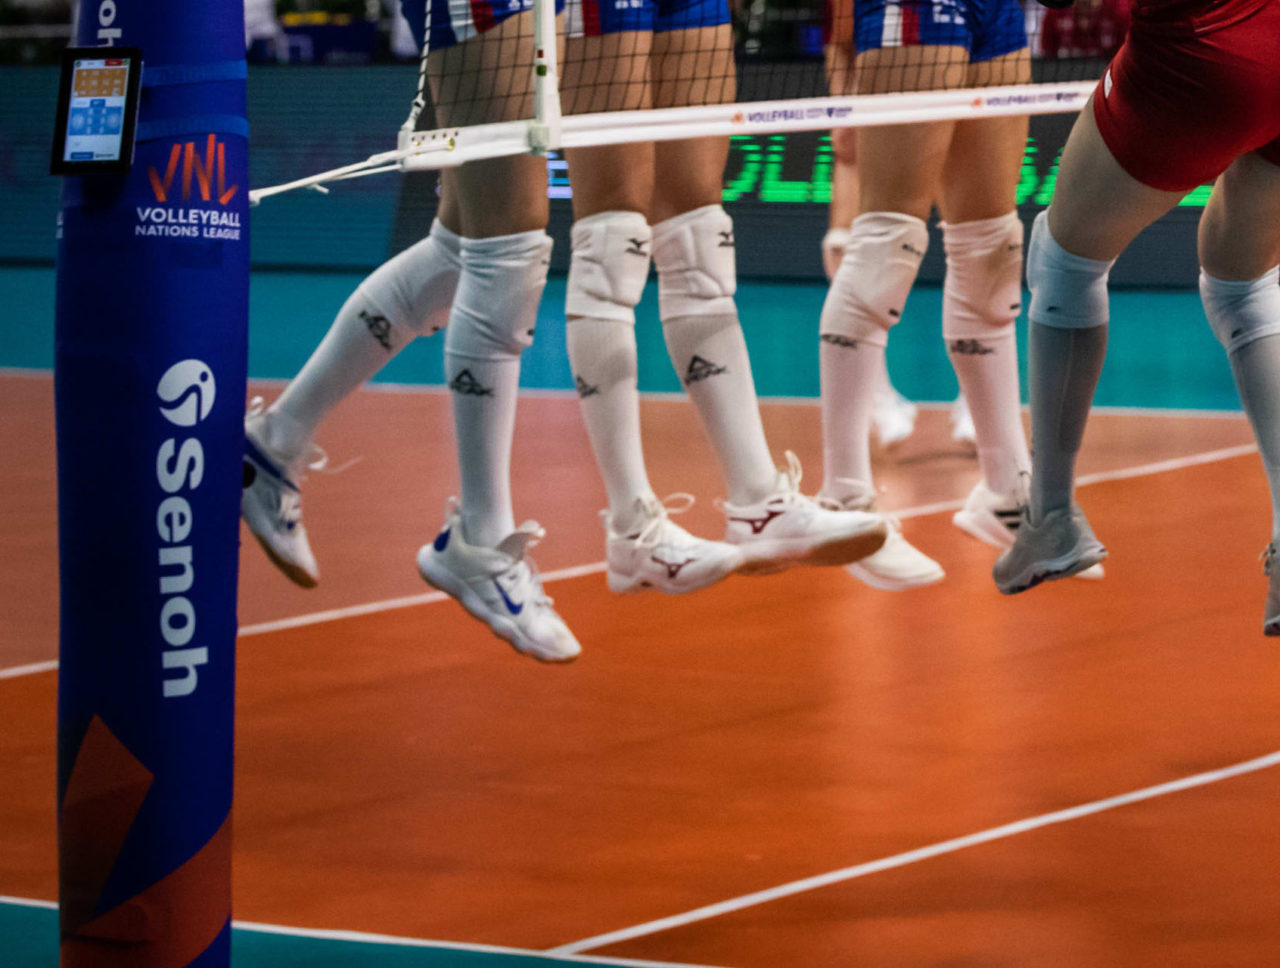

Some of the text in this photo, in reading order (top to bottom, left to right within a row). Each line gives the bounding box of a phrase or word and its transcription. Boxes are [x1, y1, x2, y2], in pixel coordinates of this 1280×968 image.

[148, 133, 240, 206] VNL
[135, 224, 241, 241] NATIONS LEAGUE
[137, 206, 242, 228] VOLLEYBALL
[156, 437, 209, 697] Senoh
